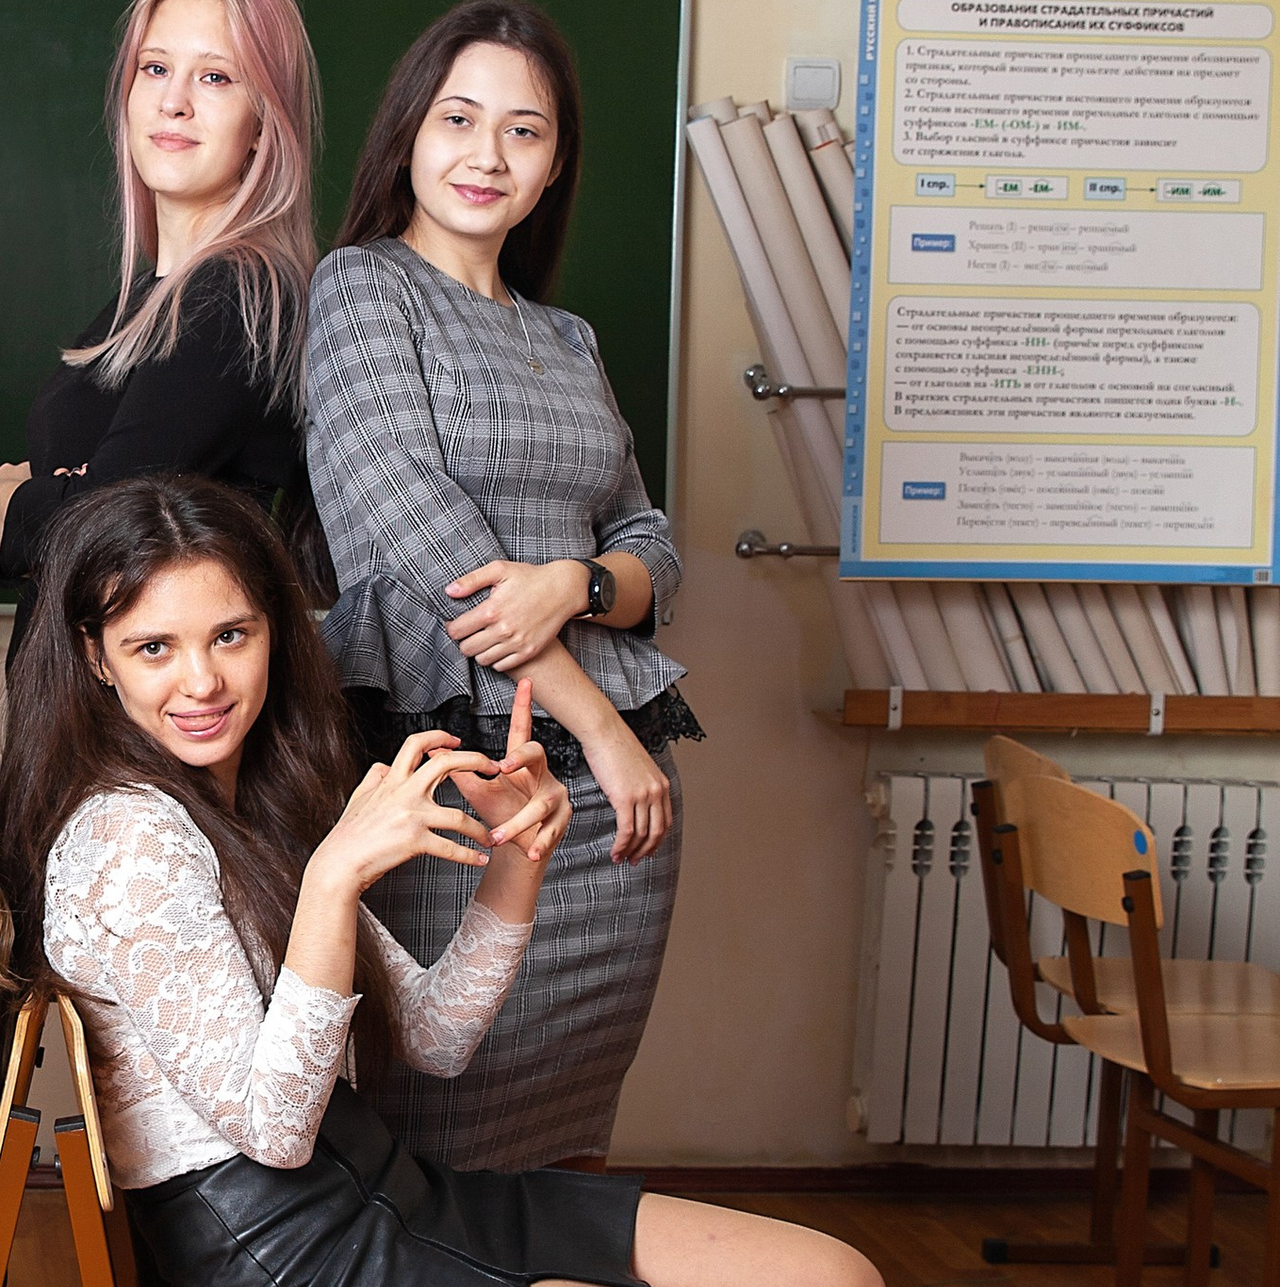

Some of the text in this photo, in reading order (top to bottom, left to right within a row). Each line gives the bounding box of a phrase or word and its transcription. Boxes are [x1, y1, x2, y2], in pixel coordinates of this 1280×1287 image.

[951, 3, 1214, 18] ОБРАЗОВАНИЕ СТРАДАТЕЛЬНЫХ ПРИЧАСТИЙ
[979, 18, 1184, 31] И ПРАВОПИСАНИЕ ИХ СУФФИКСОВ
[894, 392, 902, 401] В
[894, 406, 902, 415] В
